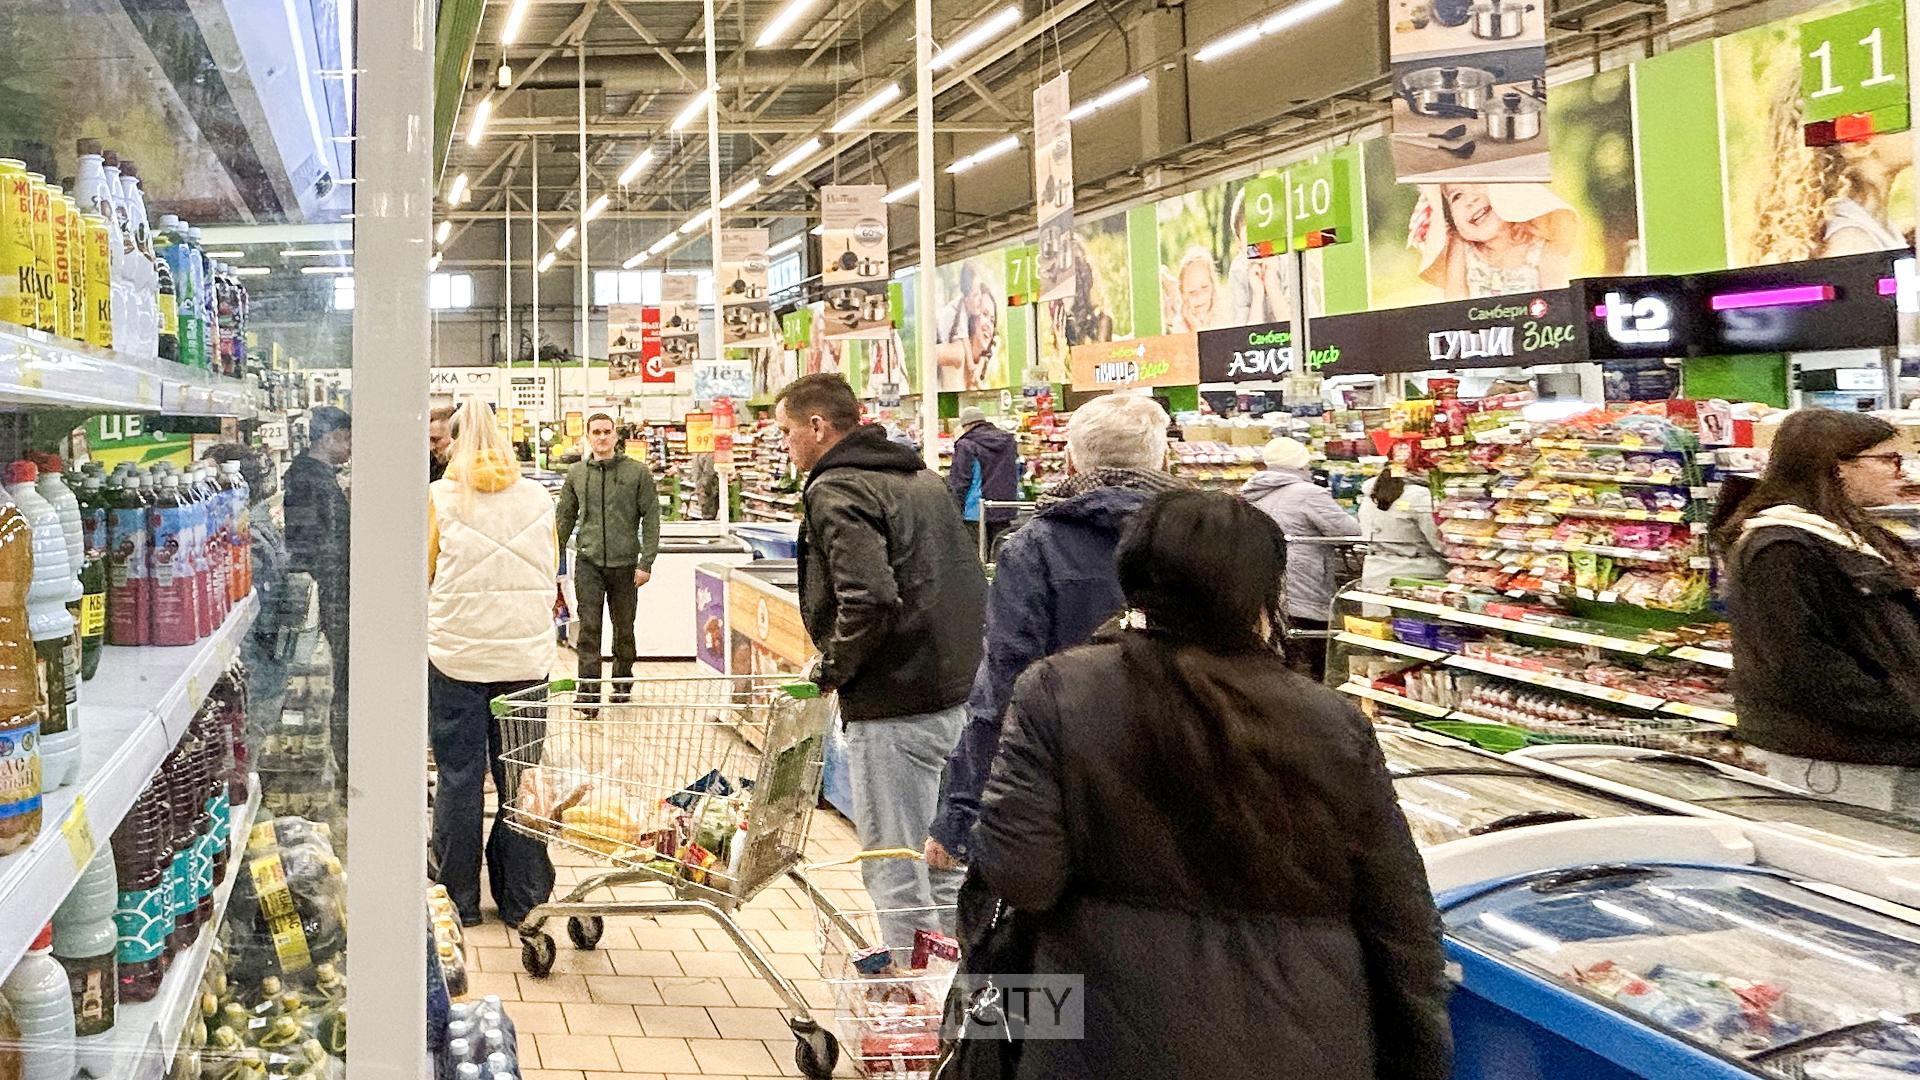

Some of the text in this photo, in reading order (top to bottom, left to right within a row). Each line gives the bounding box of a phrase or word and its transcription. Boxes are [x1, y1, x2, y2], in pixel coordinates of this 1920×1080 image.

[1807, 26, 1896, 99] 11
[1256, 178, 1331, 229] 9 10
[55, 214, 70, 285] БОЧКА
[1011, 258, 1023, 287] 7
[1468, 303, 1529, 321] Самбери
[702, 364, 746, 382] Лёд
[1226, 346, 1294, 377] АЗИЯ
[100, 413, 141, 442] ЦЕ
